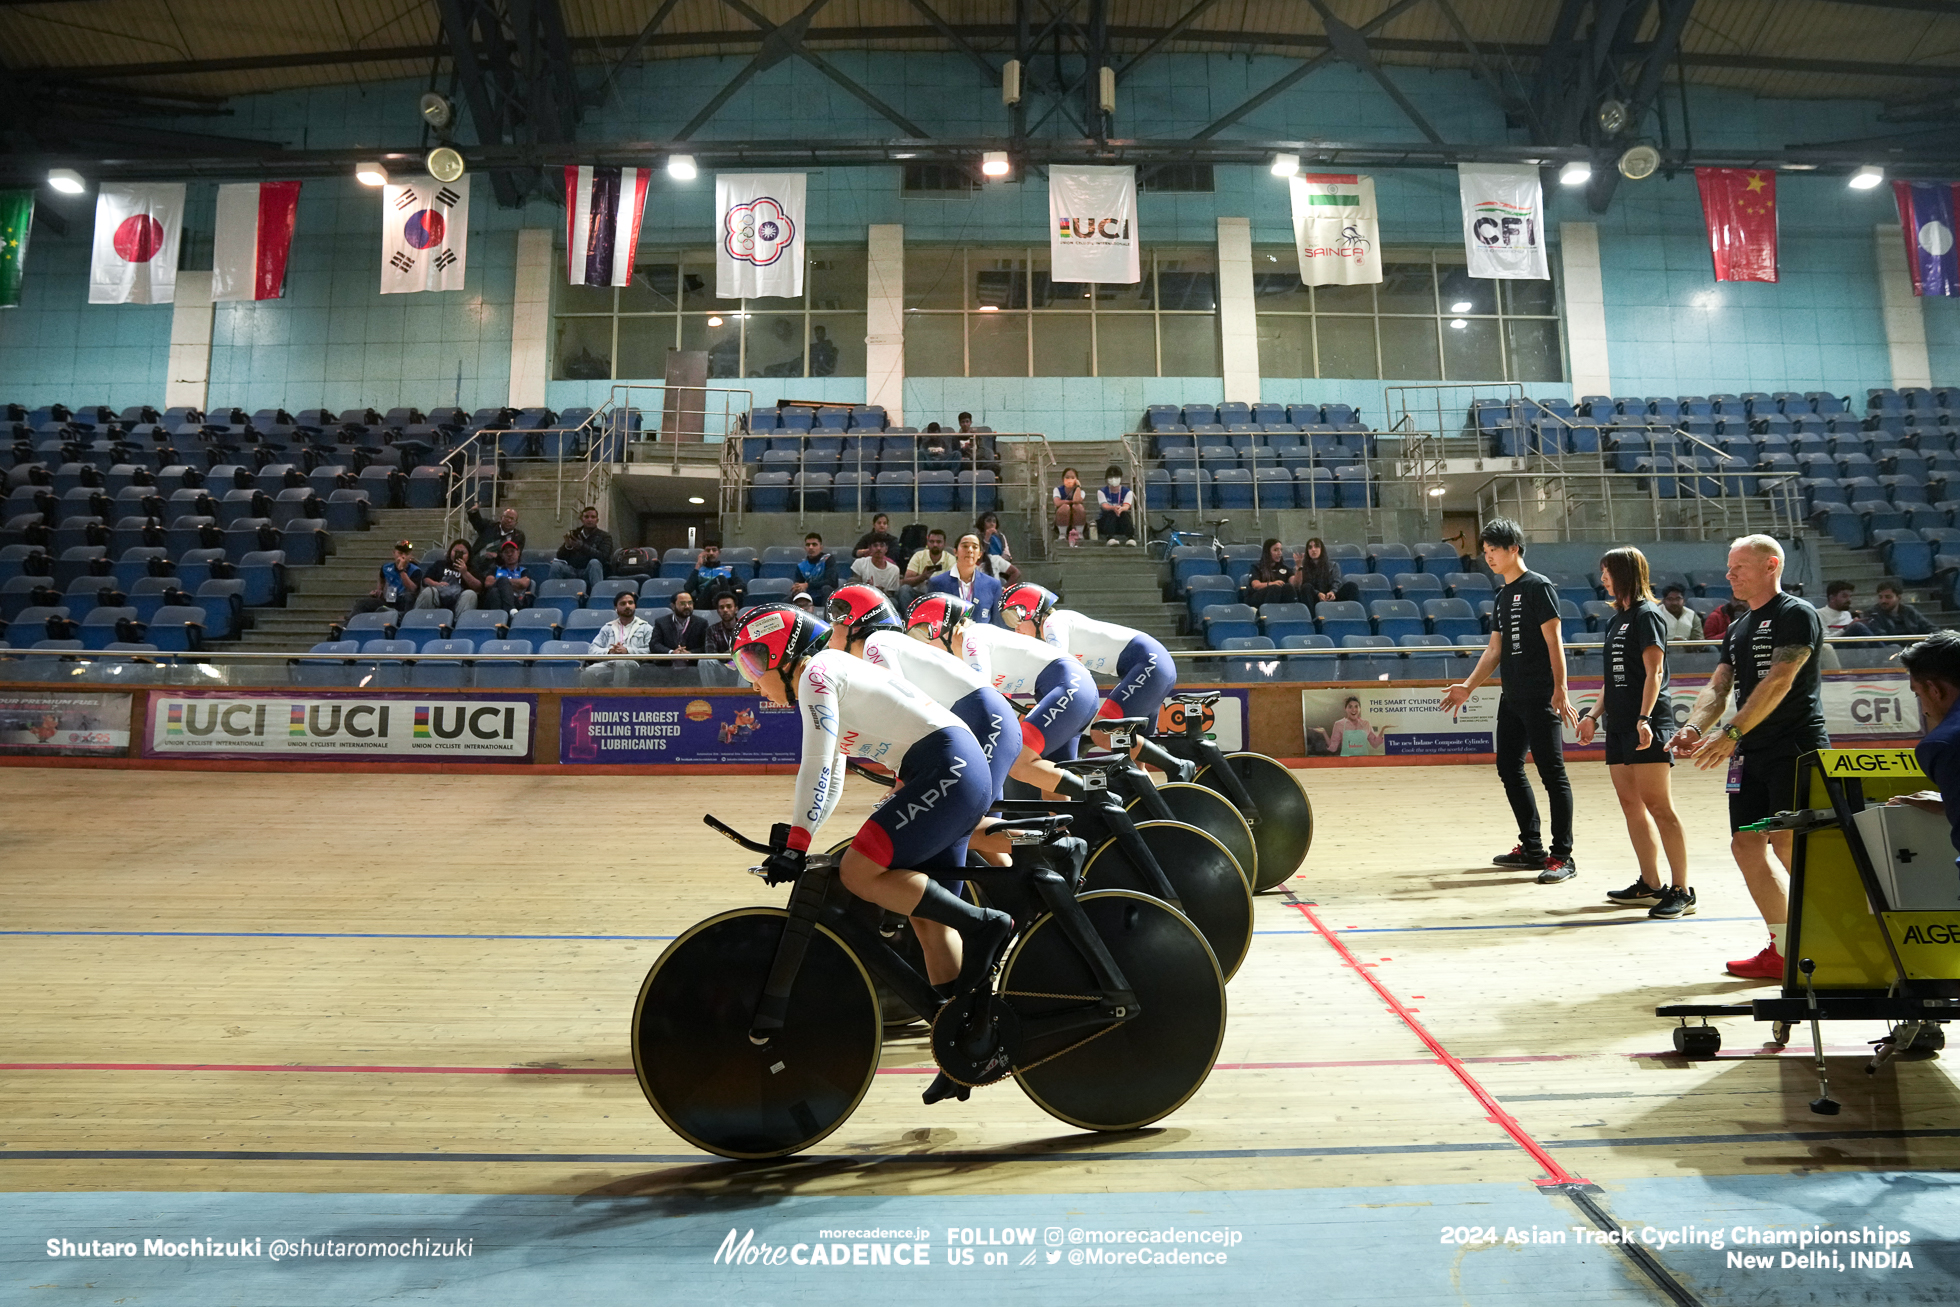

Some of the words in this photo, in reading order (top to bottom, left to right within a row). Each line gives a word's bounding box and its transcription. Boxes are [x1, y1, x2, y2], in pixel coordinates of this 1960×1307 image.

[1072, 217, 1130, 240] UCI
[1474, 217, 1536, 246] CFI
[1305, 247, 1364, 258] SAINCA
[1121, 653, 1158, 701] JAPAN
[1042, 672, 1082, 727] JAPAN
[1851, 697, 1902, 723] CFI
[185, 704, 266, 736] UCI
[308, 705, 390, 738] UCI
[433, 706, 515, 739] UCI
[588, 725, 631, 736] SELLING
[634, 725, 681, 736] TRUSTED
[590, 711, 630, 722] INDIA'S
[632, 711, 679, 722] LARGEST
[601, 739, 667, 750] LUBRICANTS
[983, 713, 1003, 763] PAN
[1434, 739, 1463, 748] Composite
[1464, 738, 1490, 747] Cylinder.
[807, 766, 831, 822] Cyclers
[895, 755, 968, 830] JAPAN
